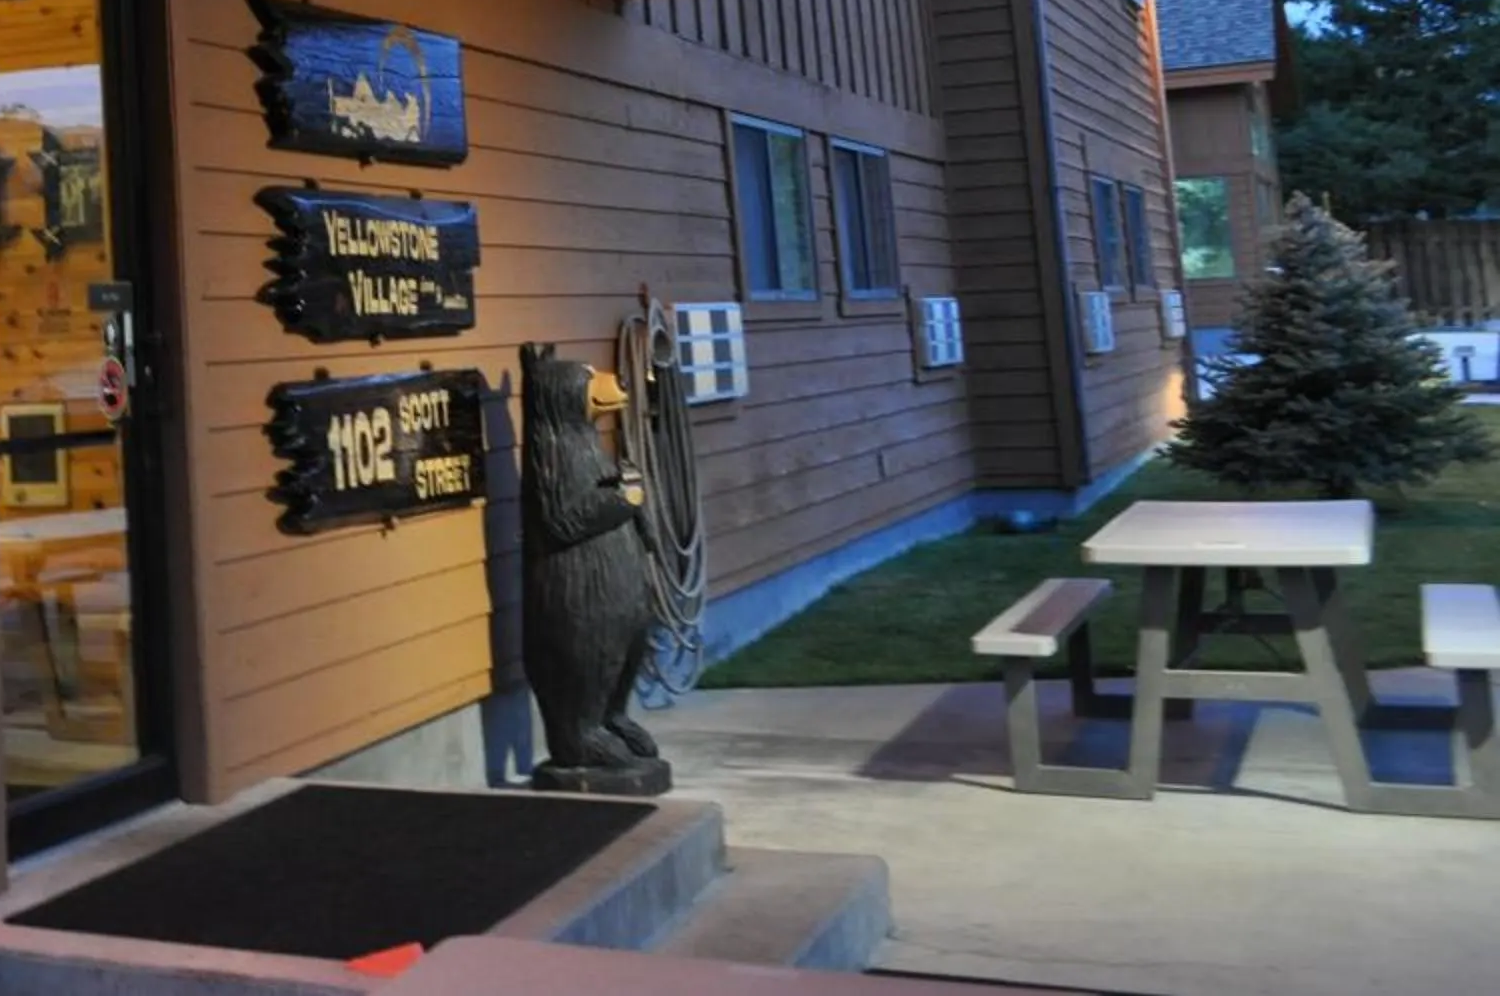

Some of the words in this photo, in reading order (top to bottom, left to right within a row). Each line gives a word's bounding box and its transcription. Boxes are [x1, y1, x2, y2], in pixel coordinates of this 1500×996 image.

[322, 209, 439, 261] YELLOWSTONE
[348, 269, 419, 316] VILLAGE
[328, 406, 395, 491] 1102
[399, 388, 450, 434] SCOTT
[415, 454, 471, 500] STREET
